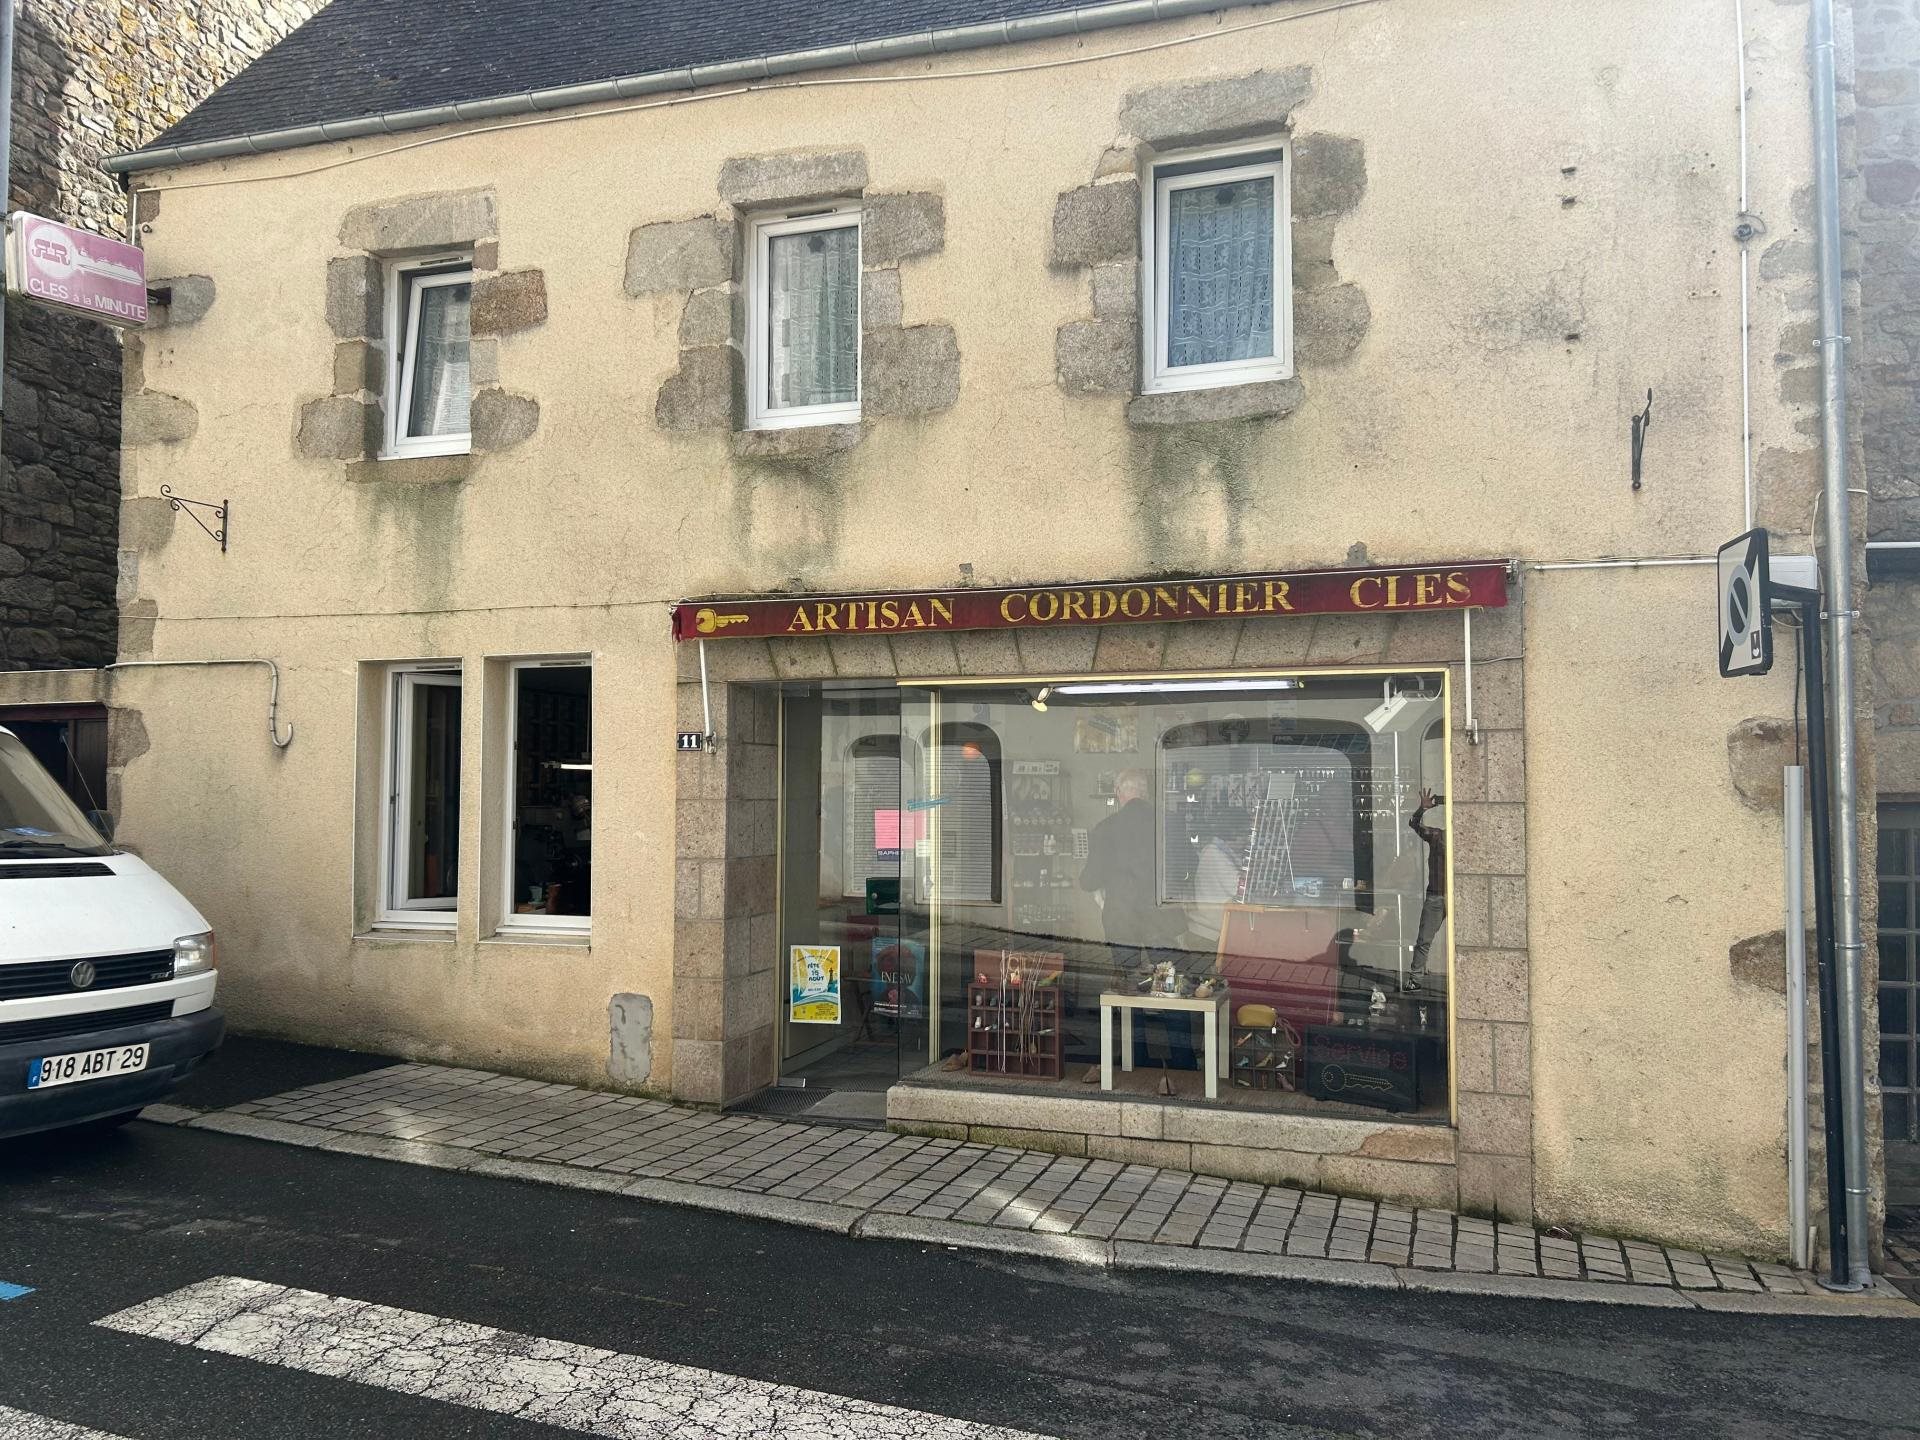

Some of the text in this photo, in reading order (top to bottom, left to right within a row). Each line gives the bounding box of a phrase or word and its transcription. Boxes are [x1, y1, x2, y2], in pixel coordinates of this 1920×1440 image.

[29, 277, 69, 299] CLES
[83, 295, 92, 305] la
[94, 294, 146, 320] MINUTE
[786, 571, 1473, 631] ARTISAN CORDONNIER CLES
[681, 734, 698, 748] 11
[41, 1046, 145, 1082] 918 ABT 29
